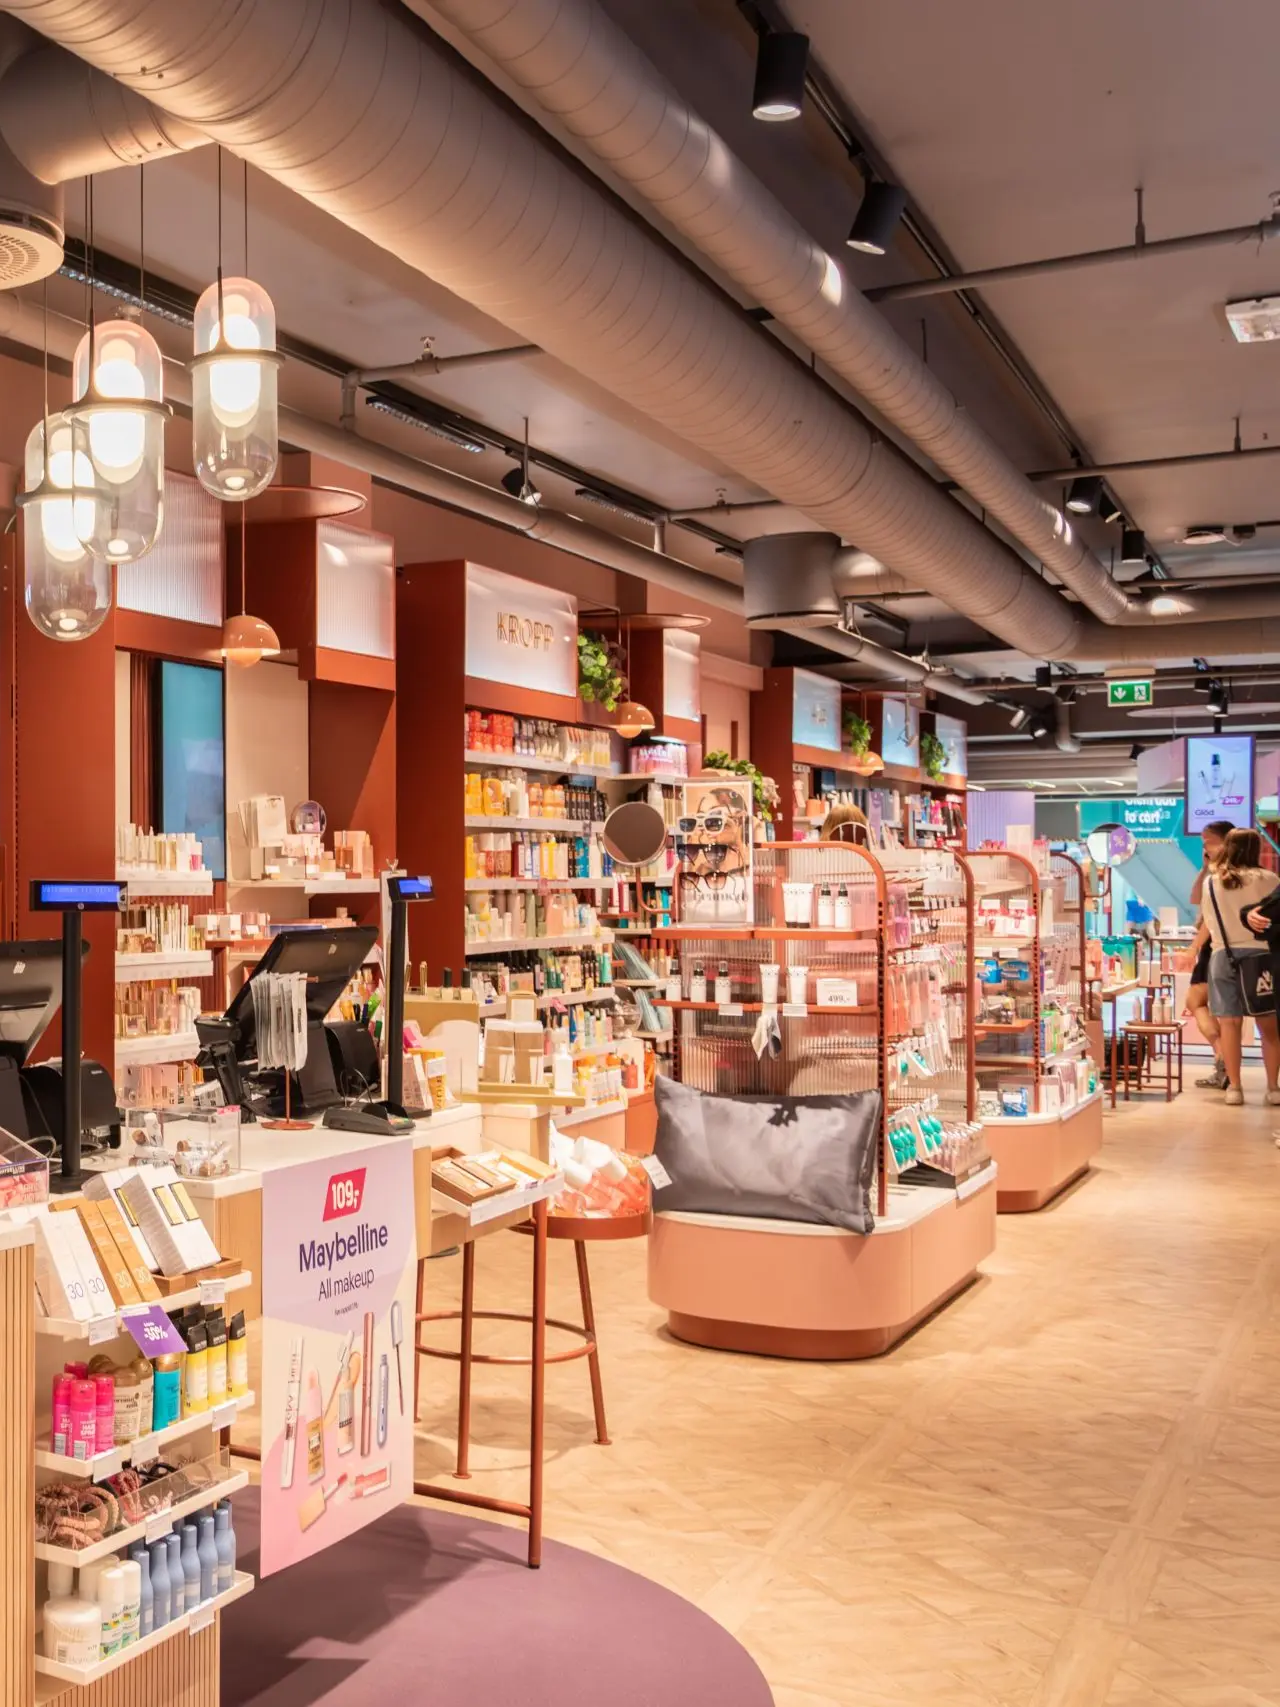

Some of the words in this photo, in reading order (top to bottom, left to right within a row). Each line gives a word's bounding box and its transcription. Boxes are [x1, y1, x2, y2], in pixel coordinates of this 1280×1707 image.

[496, 611, 554, 653] KROPP
[1124, 809, 1137, 824] to
[1138, 807, 1162, 824] cart
[331, 1179, 360, 1212] 109,-
[299, 1223, 388, 1273] Maybelline
[67, 1282, 84, 1300] 30
[88, 1277, 106, 1294] 30
[318, 1278, 332, 1302] All
[333, 1268, 375, 1297] makeup
